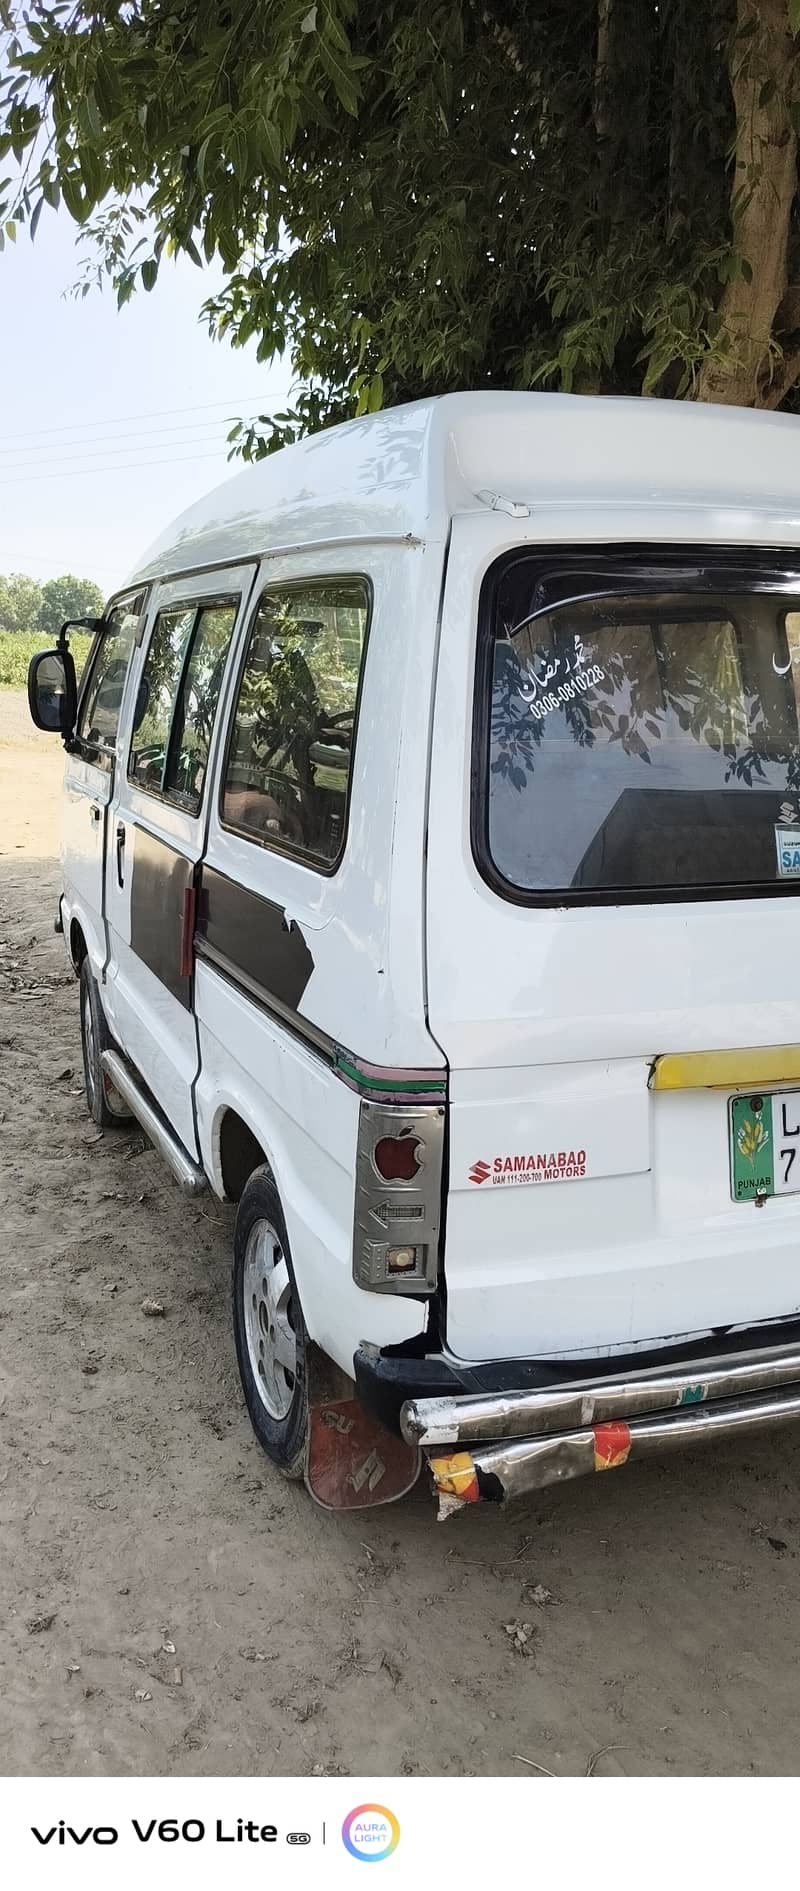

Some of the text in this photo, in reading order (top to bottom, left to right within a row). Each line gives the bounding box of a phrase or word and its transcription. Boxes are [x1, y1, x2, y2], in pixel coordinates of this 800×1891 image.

[530, 664, 605, 719] 0306-0810228
[493, 1150, 586, 1173] SAMANABAD
[543, 1165, 586, 1180] MOTORS
[738, 1177, 771, 1189] PUNJAB
